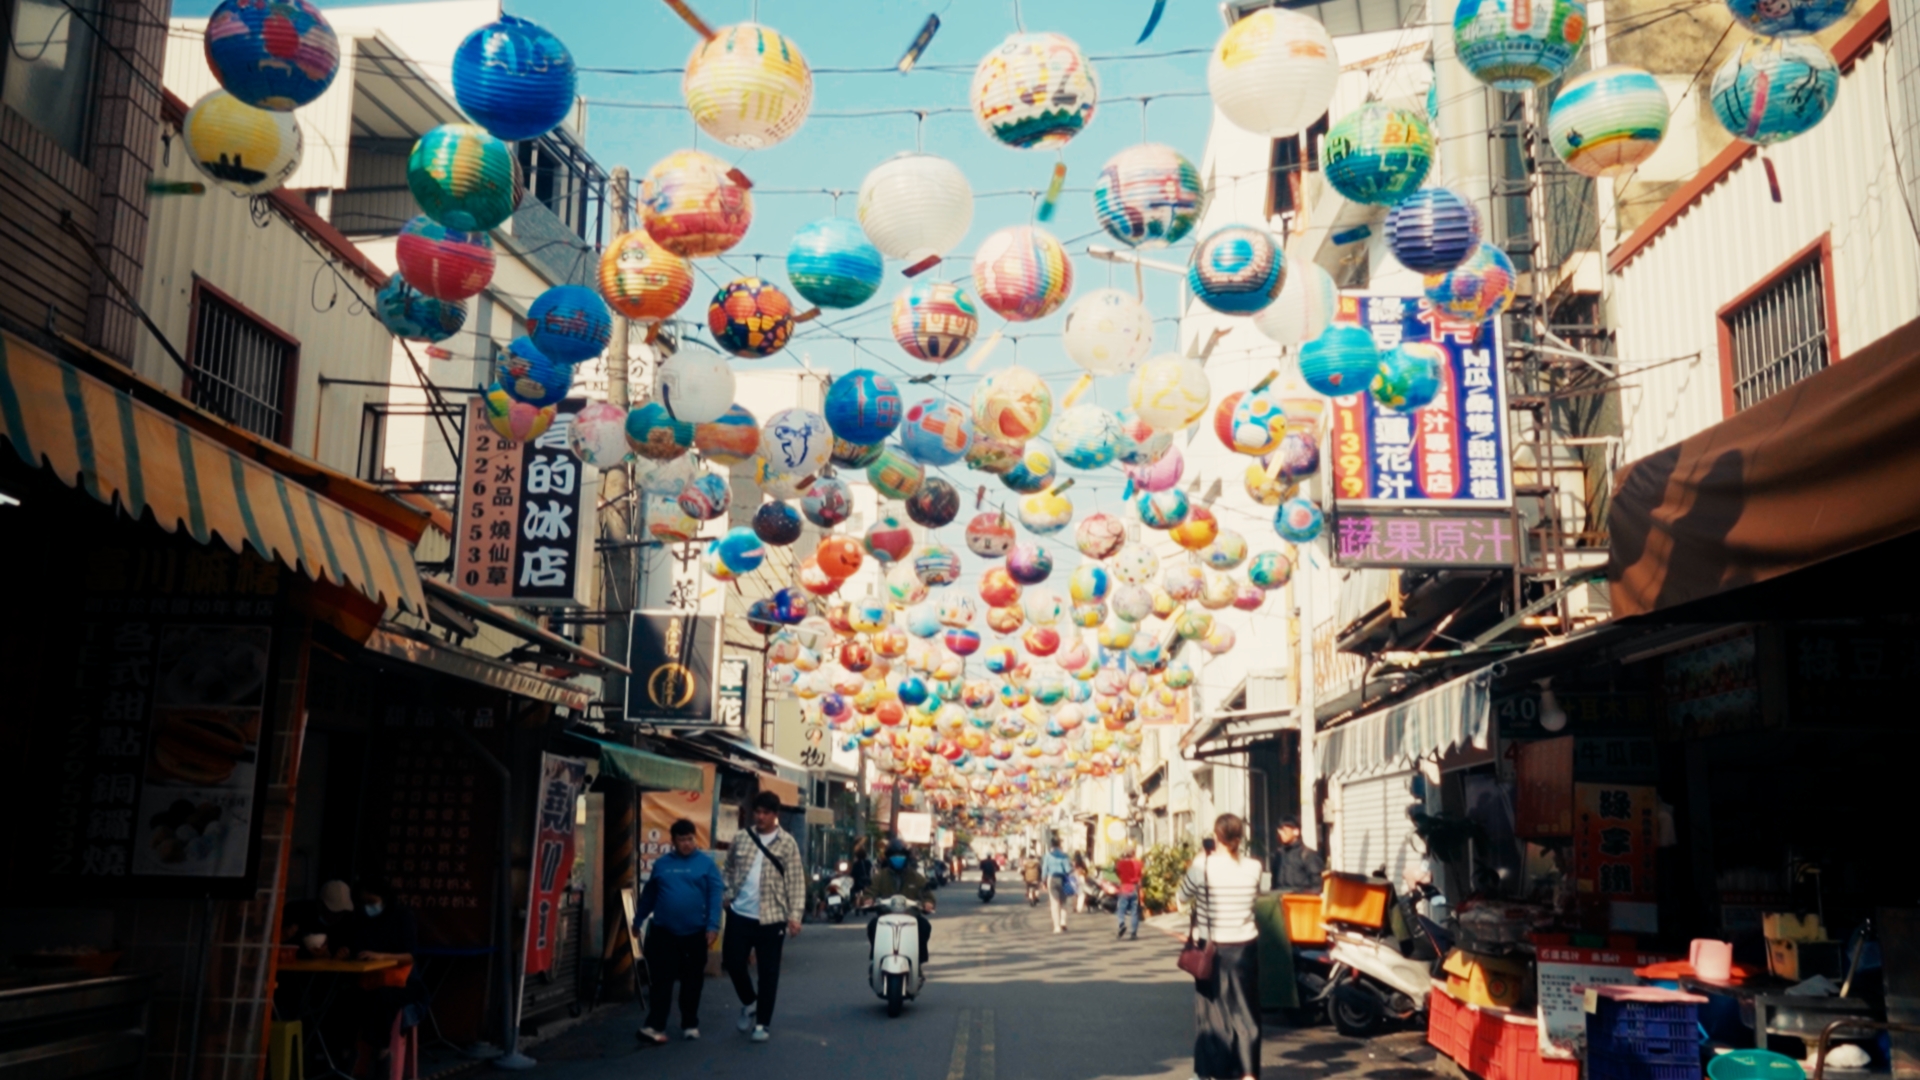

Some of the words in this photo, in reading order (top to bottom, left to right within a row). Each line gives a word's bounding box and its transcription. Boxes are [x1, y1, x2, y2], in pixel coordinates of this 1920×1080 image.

[465, 435, 490, 587] 2265530
[1501, 698, 1537, 721] 40
[1572, 742, 1653, 767] 南瓜牛
